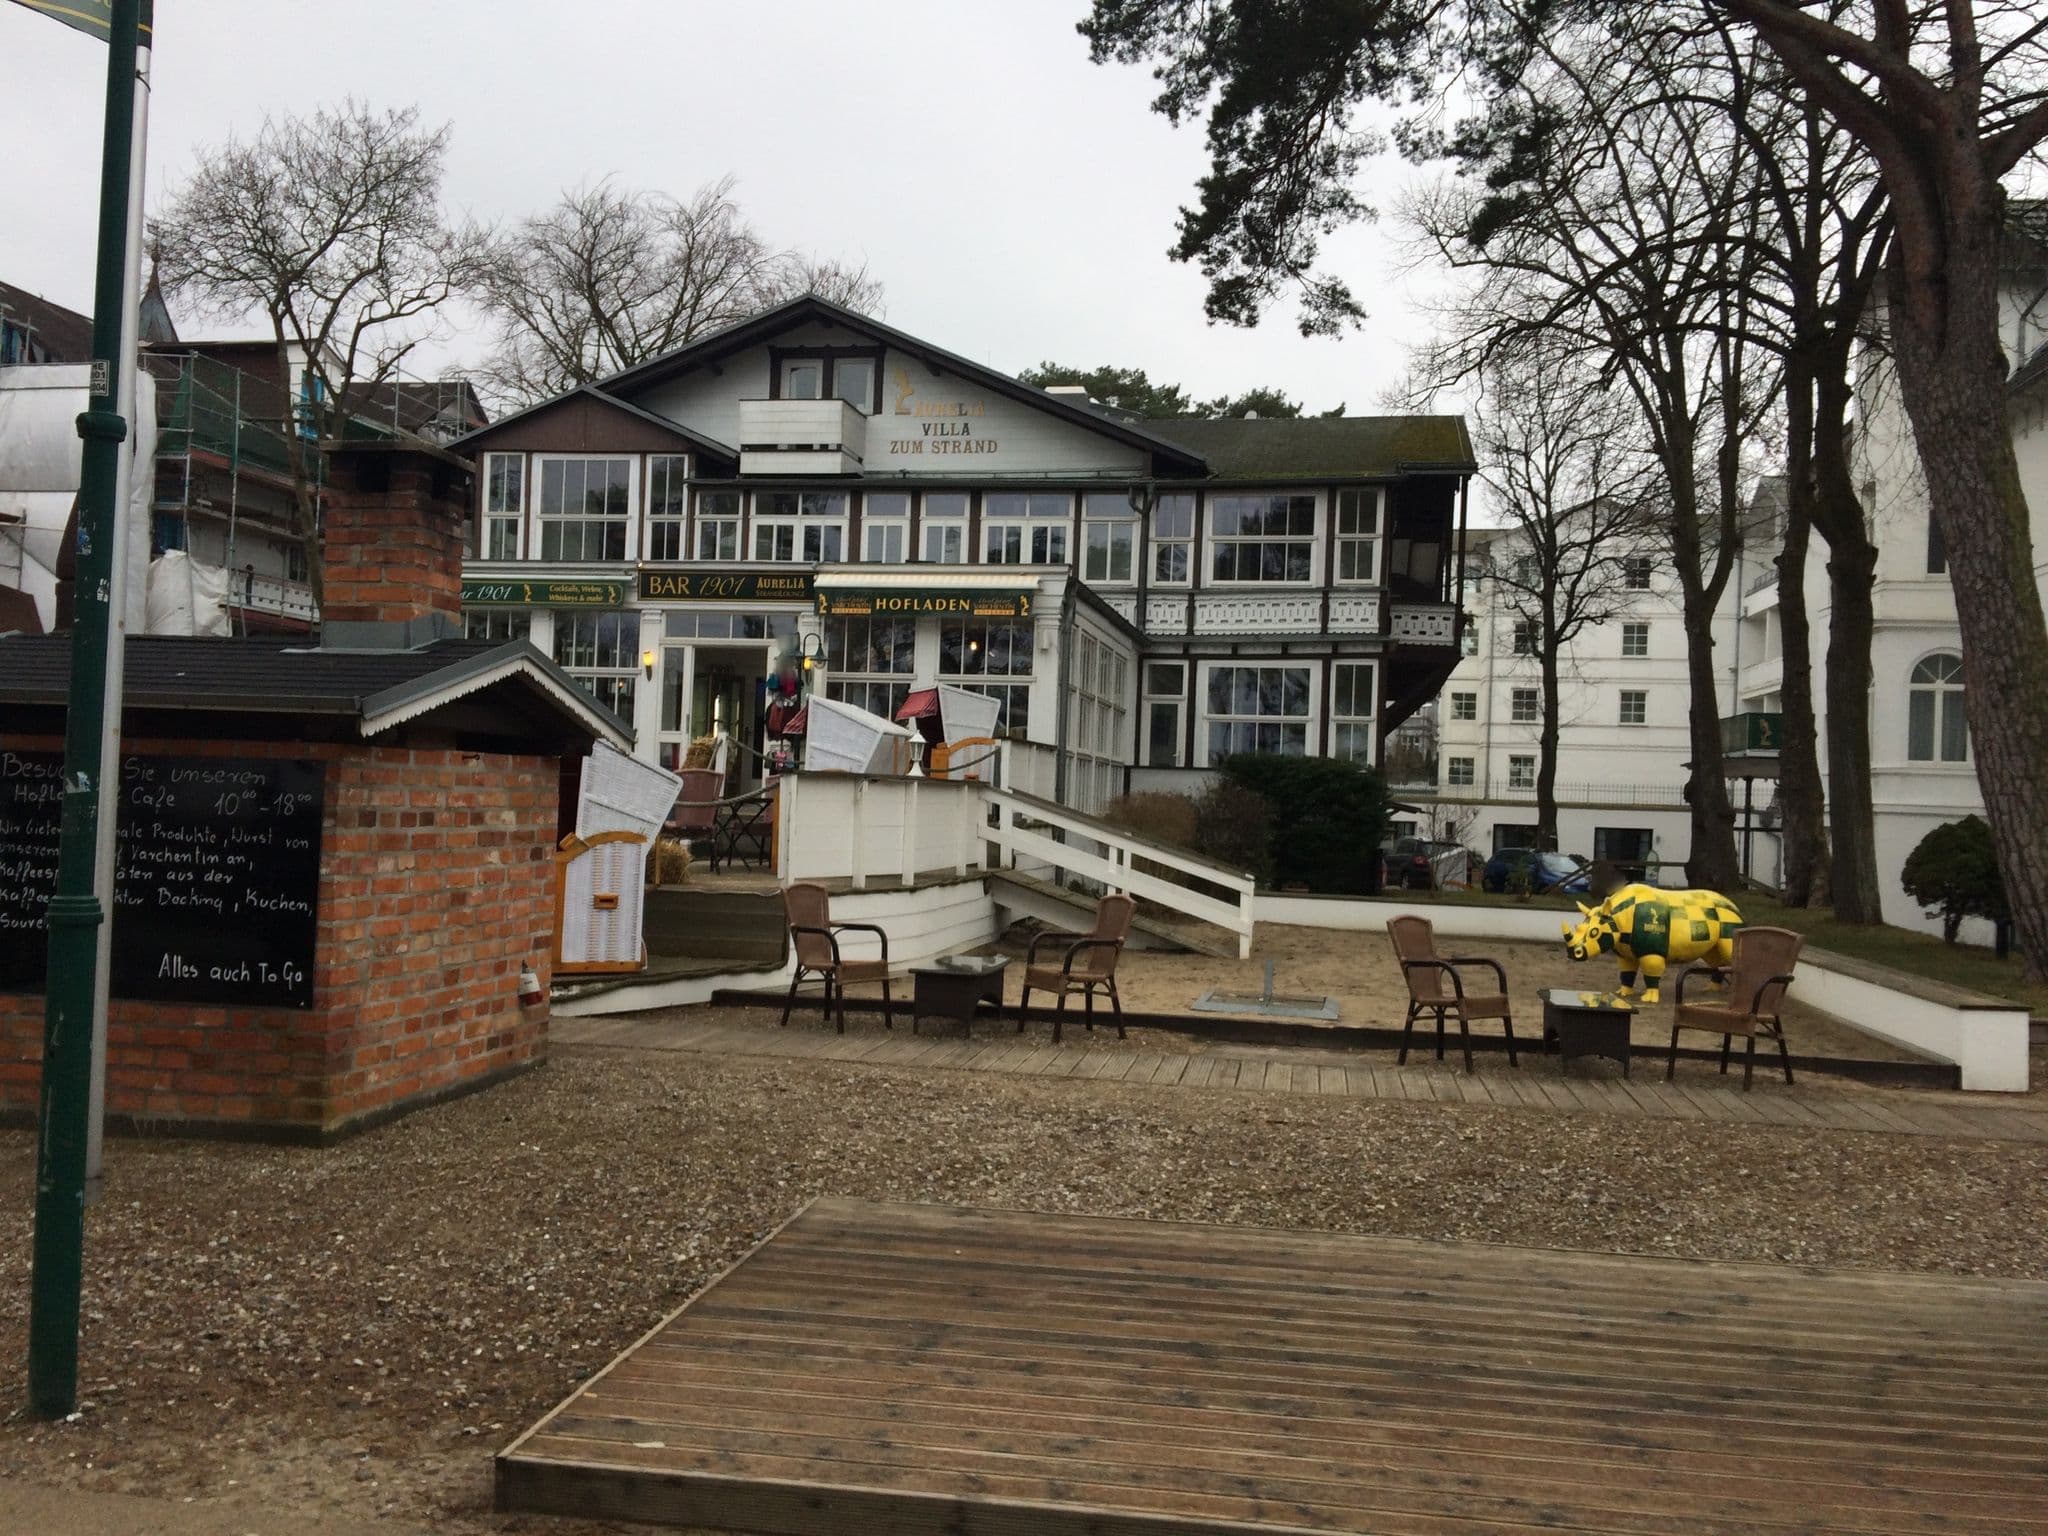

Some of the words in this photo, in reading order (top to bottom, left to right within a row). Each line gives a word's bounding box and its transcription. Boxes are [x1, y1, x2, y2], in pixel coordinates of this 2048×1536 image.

[922, 423, 970, 436] VILLA
[890, 440, 923, 454] ZUM
[931, 440, 998, 454] STRAND
[650, 576, 690, 594] BAR
[699, 576, 746, 596] 1901
[757, 576, 805, 589] AURELIA
[476, 584, 513, 600] 1901
[875, 597, 971, 611] HOFLADEN
[124, 757, 155, 782] Sie
[171, 766, 267, 786] unseren
[285, 838, 310, 850] von
[166, 870, 194, 882] aus
[204, 872, 234, 884] der
[158, 952, 199, 979] Alles
[210, 962, 250, 982] auch
[258, 962, 278, 983] To
[283, 960, 303, 990] Go
